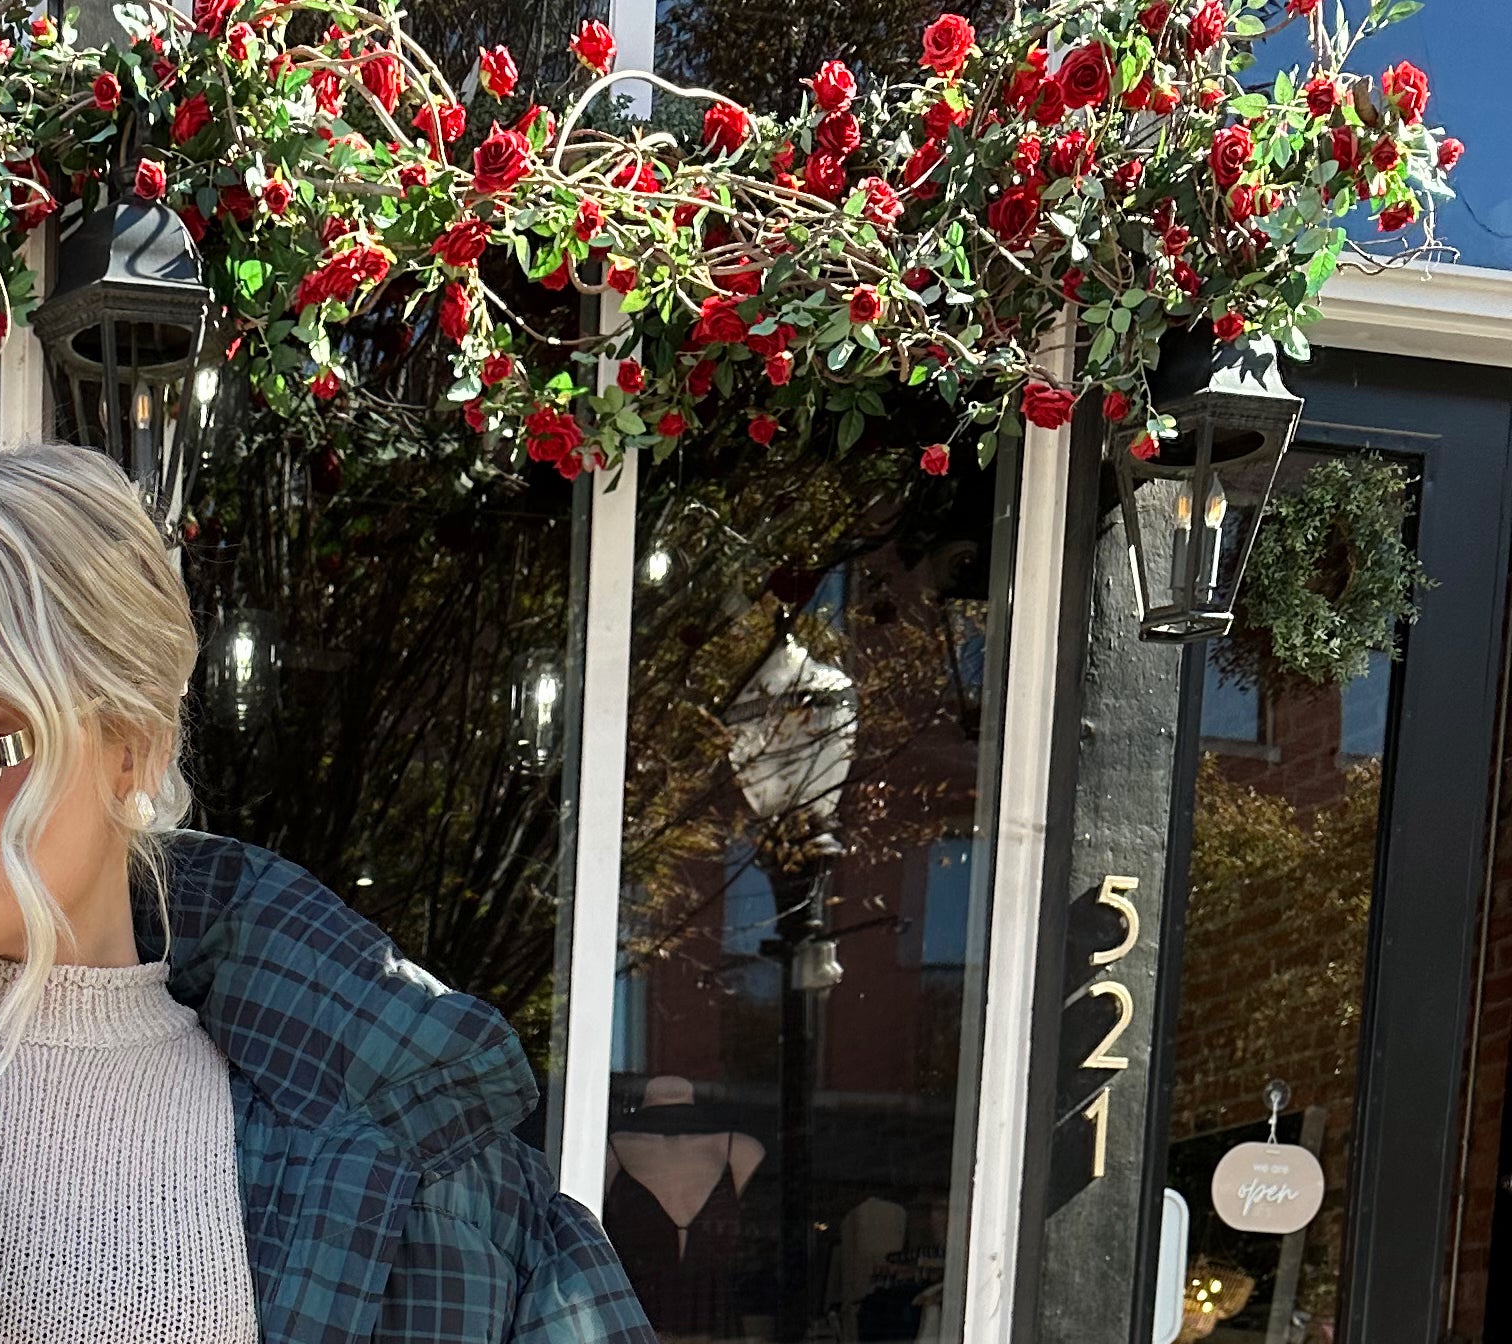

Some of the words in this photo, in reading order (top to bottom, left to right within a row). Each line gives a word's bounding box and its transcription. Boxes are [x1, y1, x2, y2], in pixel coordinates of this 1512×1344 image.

[1079, 875, 1140, 1177] 521
[1252, 1162, 1269, 1174] we
[1270, 1164, 1289, 1175] are
[1237, 1177, 1300, 1217] open
